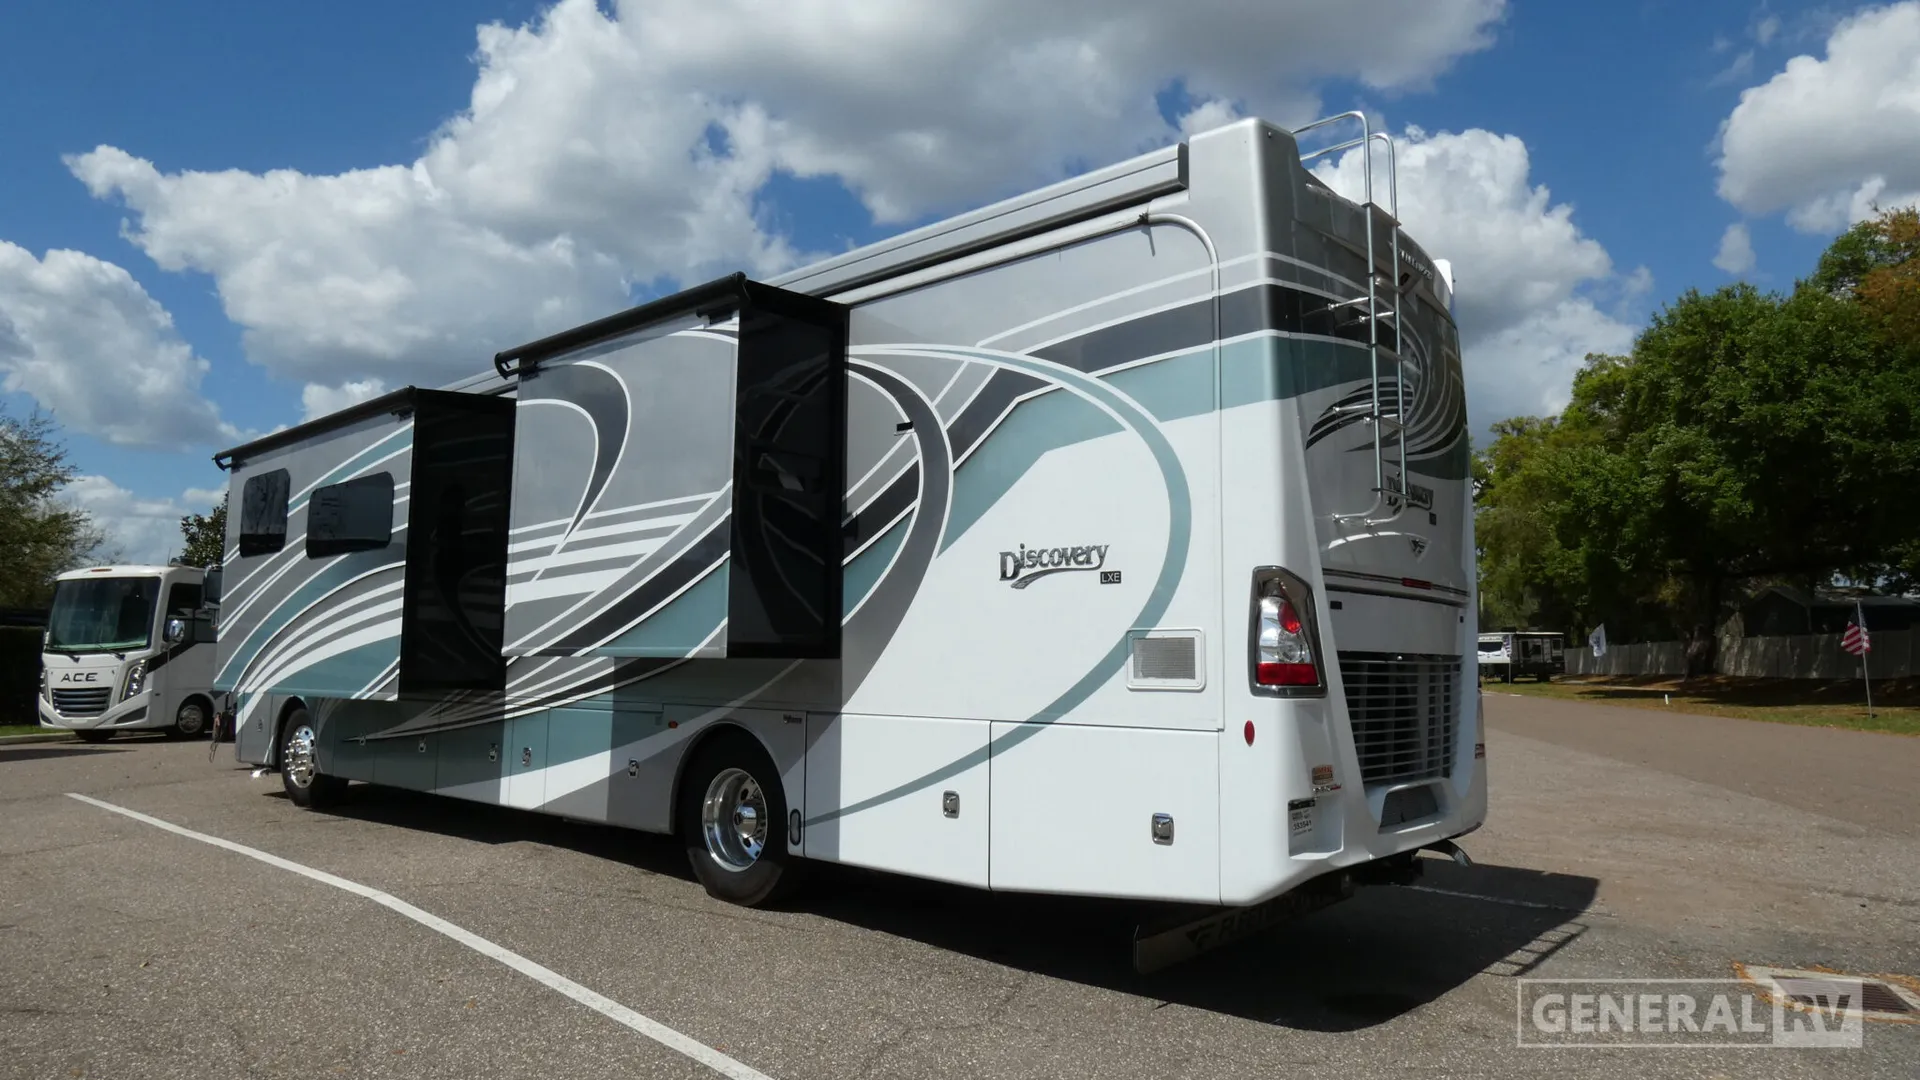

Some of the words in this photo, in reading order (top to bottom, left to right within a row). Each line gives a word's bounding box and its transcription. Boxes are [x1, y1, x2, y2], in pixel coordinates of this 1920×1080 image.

[999, 543, 1110, 583] Discovery
[1101, 572, 1120, 583] LXE
[60, 672, 98, 682] ACE
